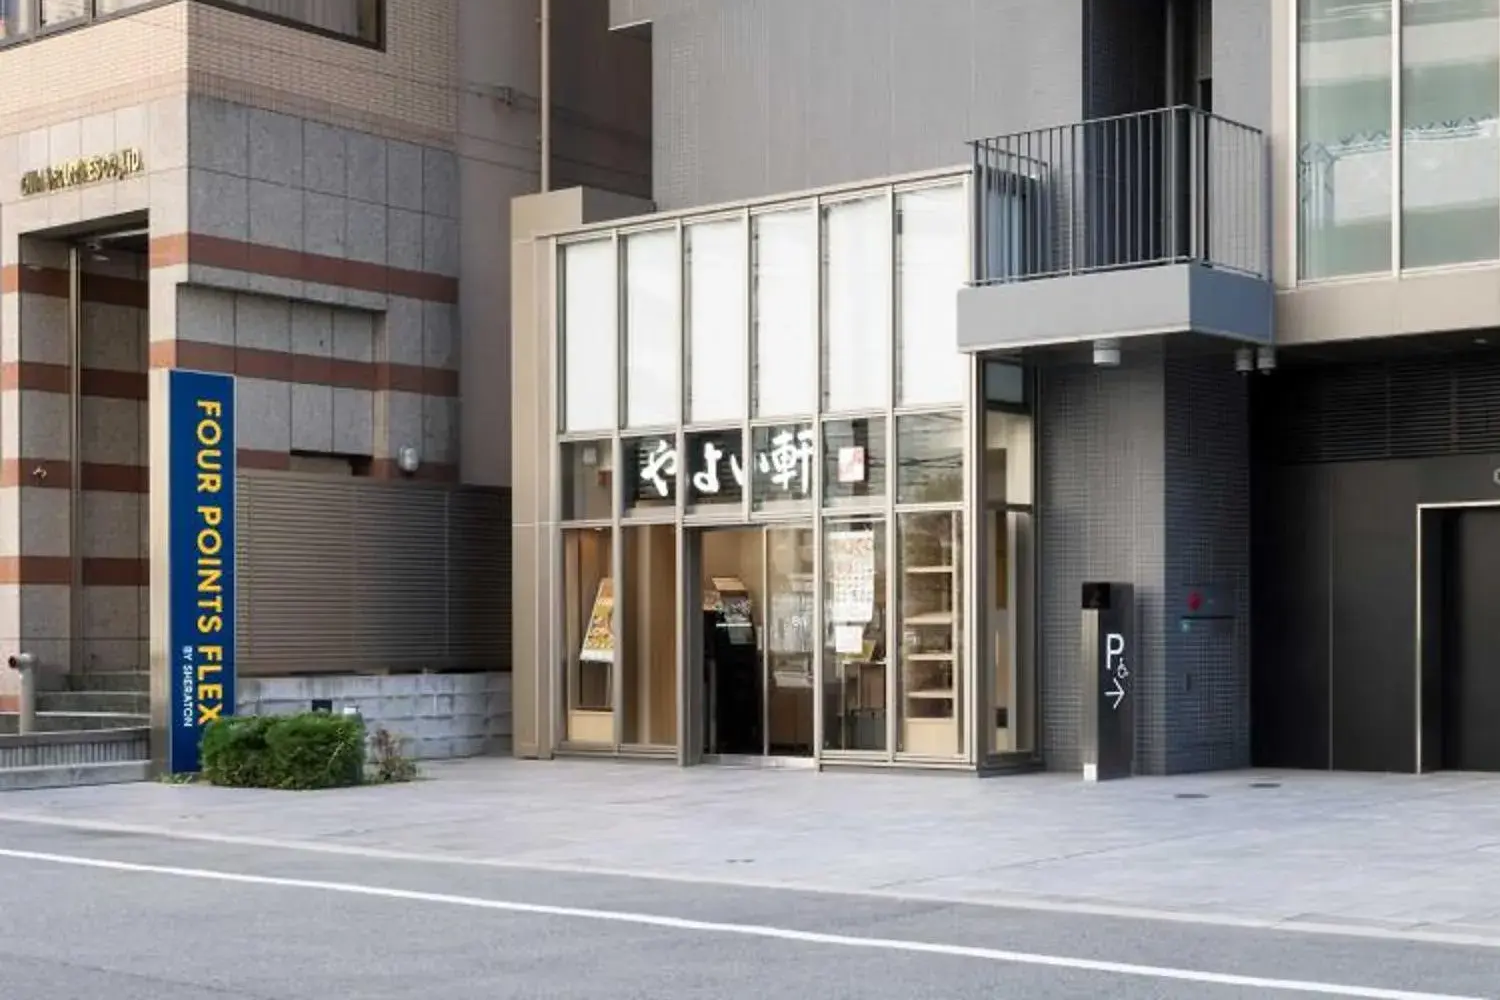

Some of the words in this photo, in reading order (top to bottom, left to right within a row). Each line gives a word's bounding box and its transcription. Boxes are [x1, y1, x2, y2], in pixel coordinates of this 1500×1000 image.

[196, 399, 222, 493] FOUR
[639, 429, 814, 497] やよい軒
[197, 505, 223, 634] POINTS
[182, 645, 193, 661] BY
[1106, 632, 1125, 670] P
[182, 664, 194, 727] SHERATON
[197, 645, 223, 726] FLEX
